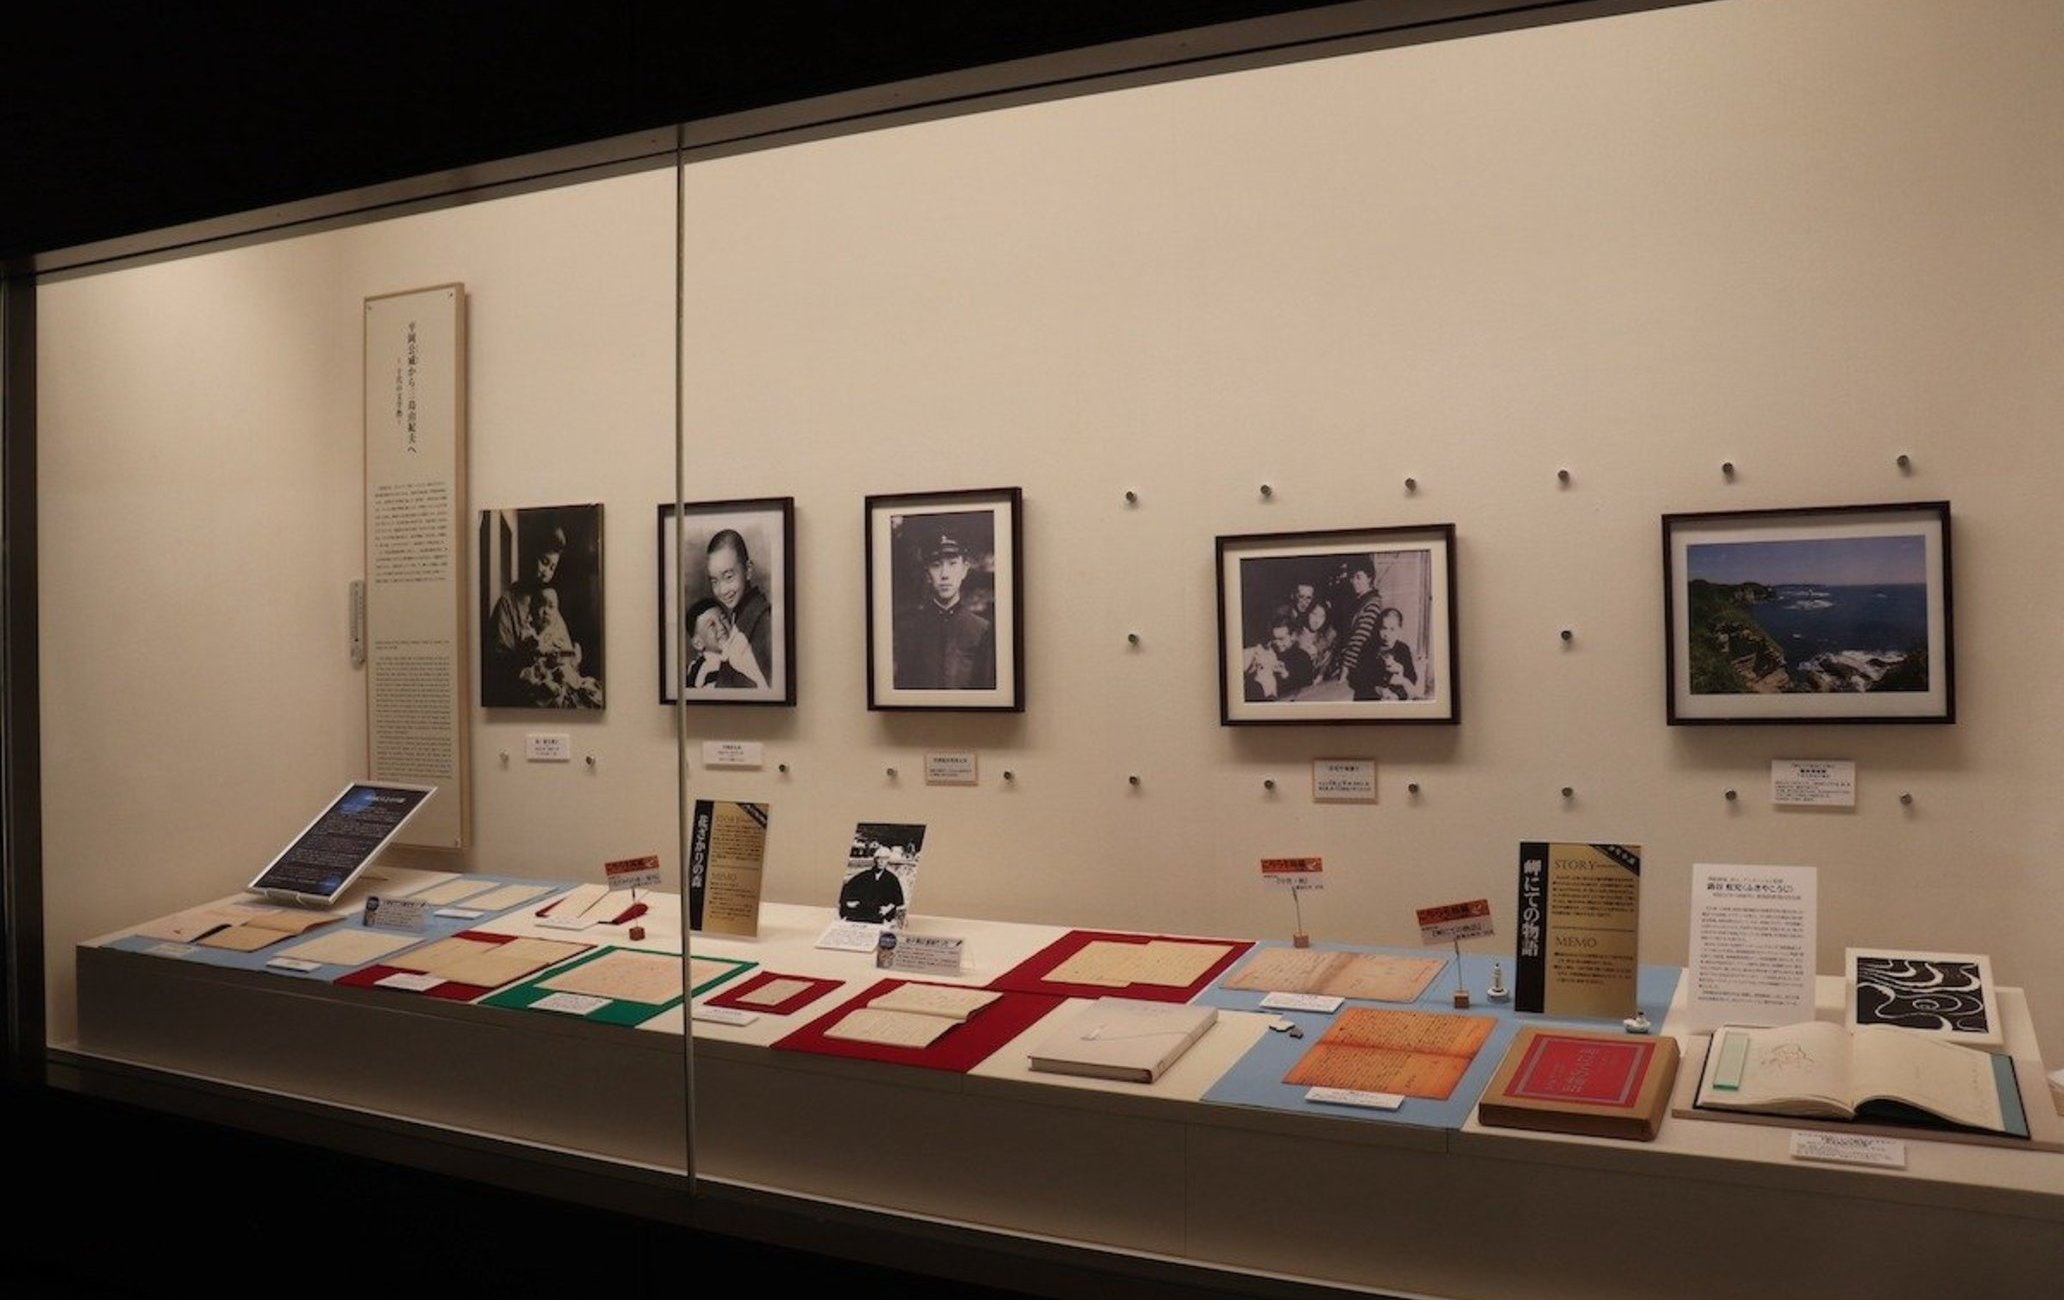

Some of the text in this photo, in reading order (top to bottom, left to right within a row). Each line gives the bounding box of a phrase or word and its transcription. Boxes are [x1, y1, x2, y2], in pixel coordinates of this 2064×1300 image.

[1554, 859, 1597, 871] STORY
[1522, 859, 1541, 957] 岬にての物語
[1555, 936, 1597, 948] MEMO
